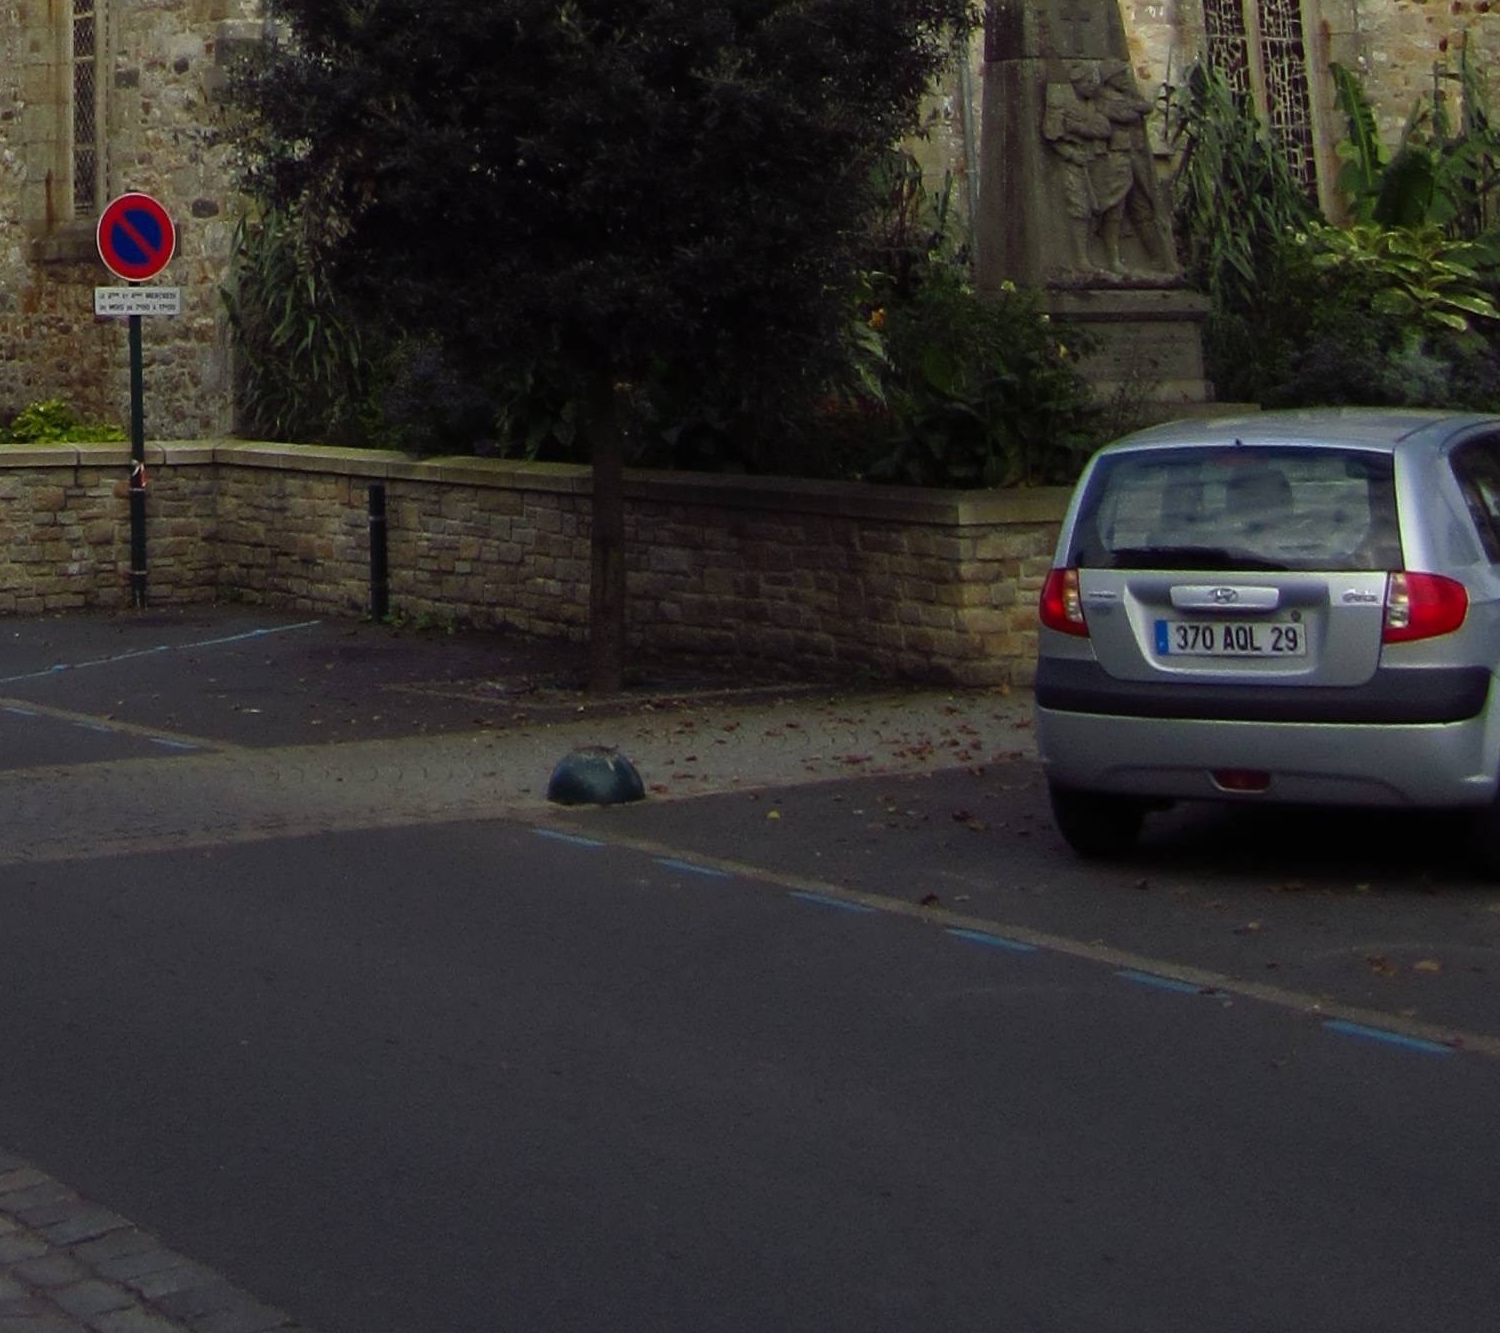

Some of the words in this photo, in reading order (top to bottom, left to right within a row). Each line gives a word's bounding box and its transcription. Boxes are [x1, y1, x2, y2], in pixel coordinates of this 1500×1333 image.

[1176, 624, 1215, 651] 370
[1223, 624, 1262, 651] AQL
[1270, 625, 1298, 652] 29
